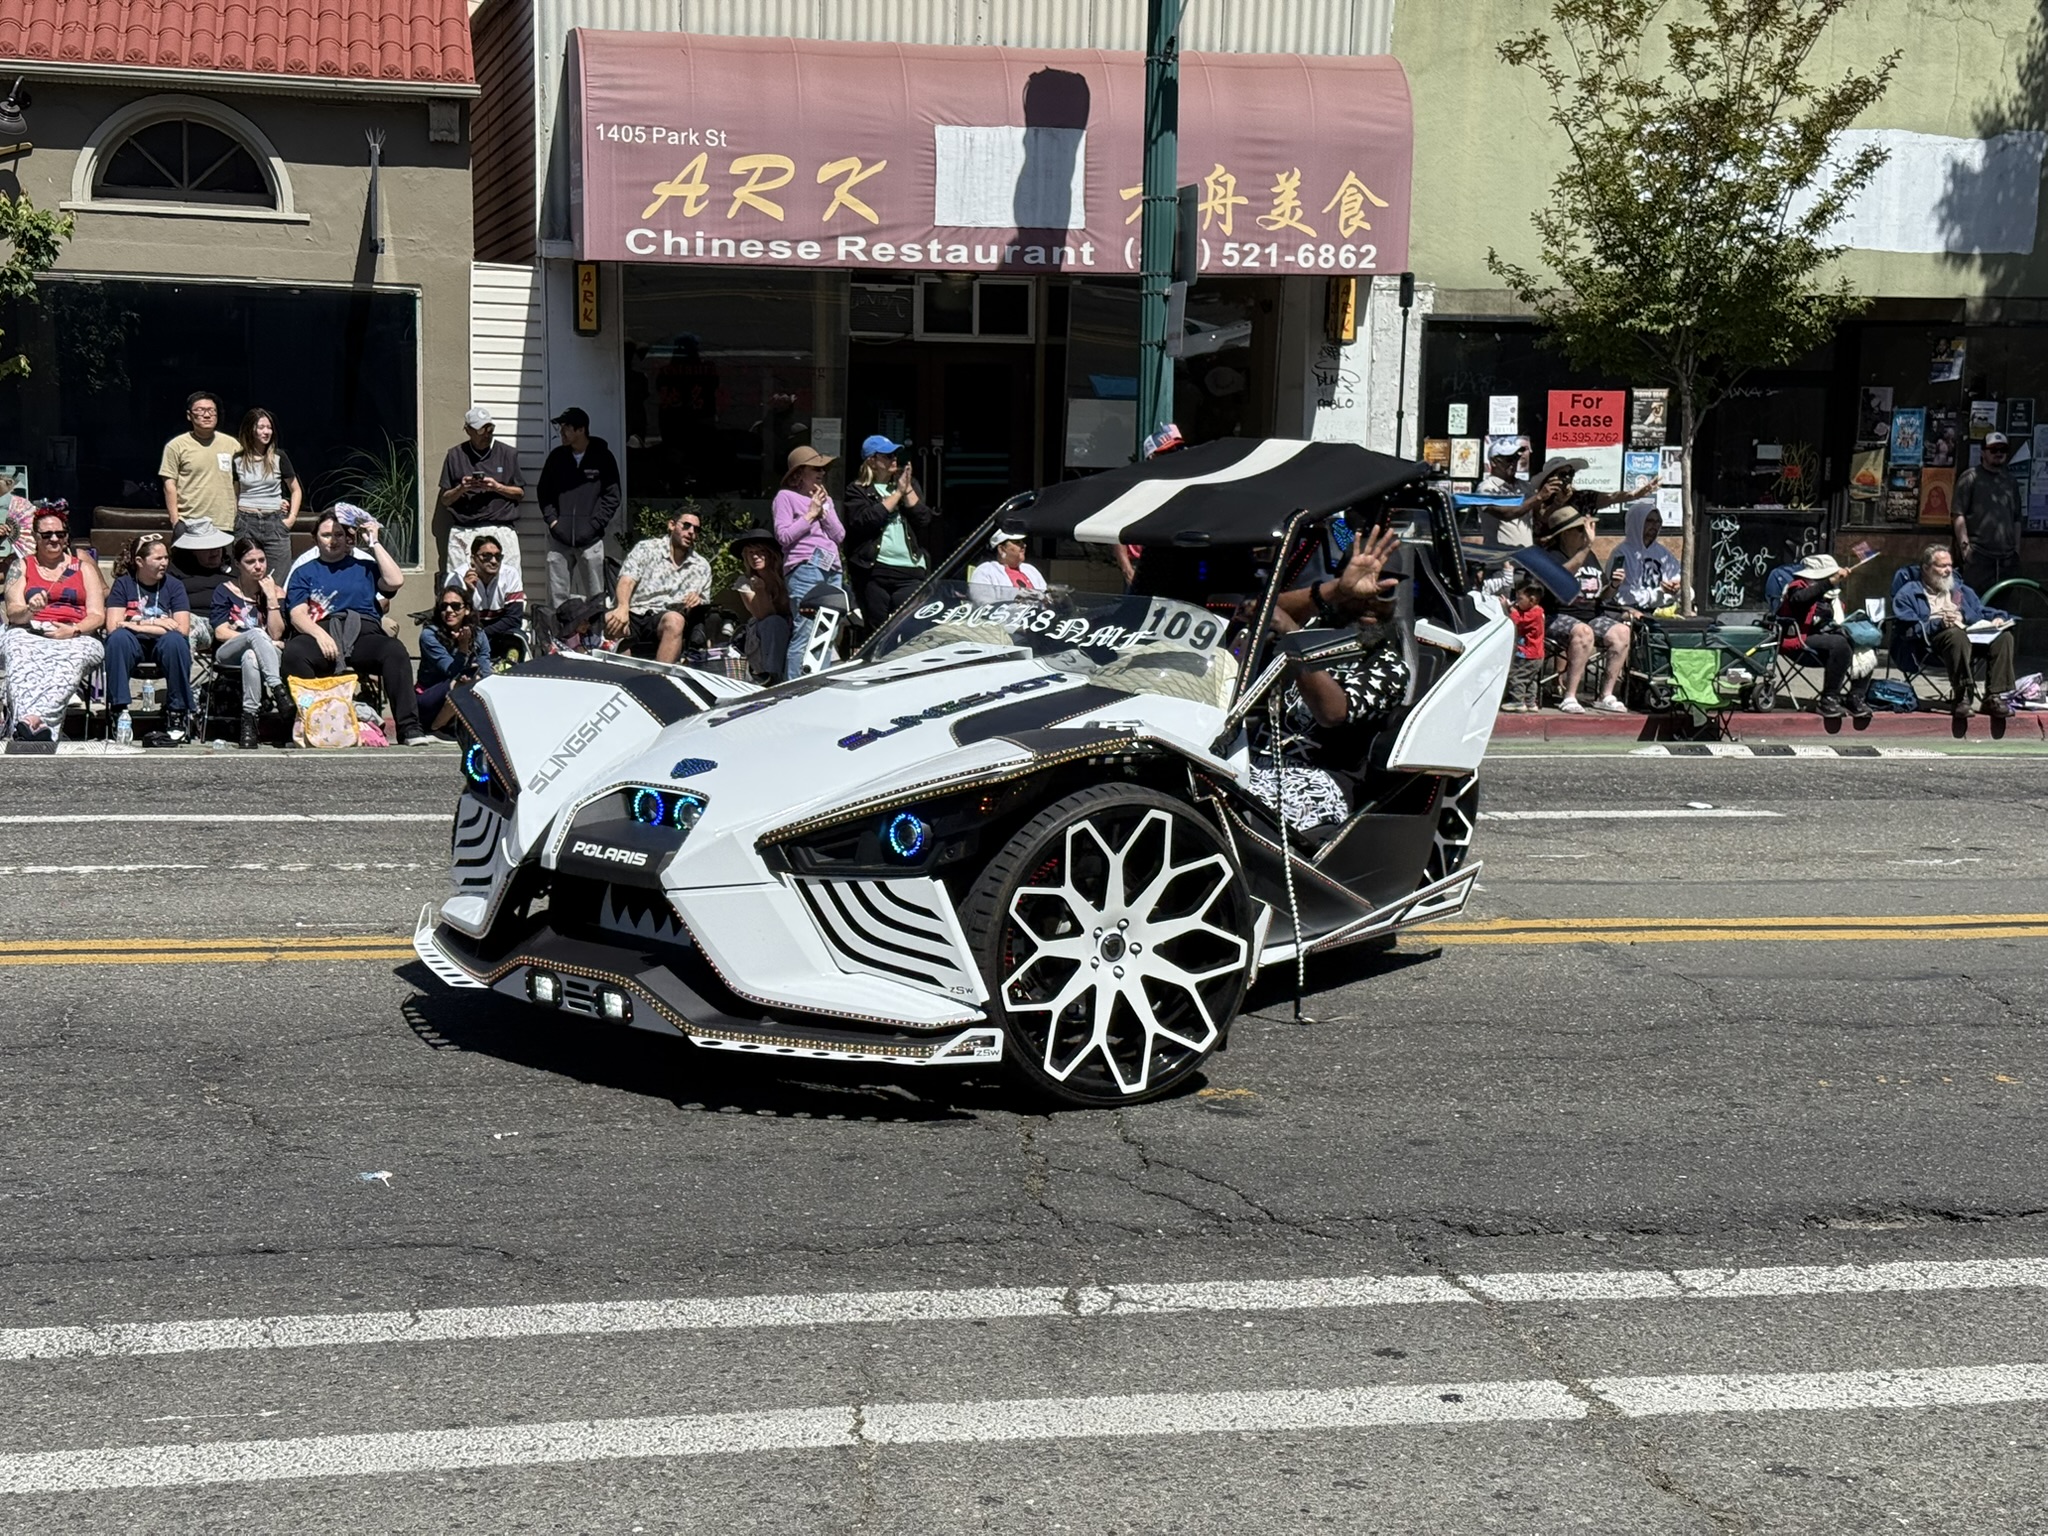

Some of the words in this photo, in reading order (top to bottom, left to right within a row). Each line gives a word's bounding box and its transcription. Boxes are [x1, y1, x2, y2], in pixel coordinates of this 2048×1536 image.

[595, 123, 646, 143] 1405
[652, 127, 700, 146] Park
[705, 129, 727, 147] St
[641, 152, 887, 225] ARK
[1119, 163, 1389, 238] 舟美食
[625, 228, 821, 260] Chinese
[837, 235, 1095, 266] Restaurant
[1221, 242, 1377, 269] 521-6862
[581, 271, 594, 323] ARK
[1558, 412, 1613, 427] Lease
[1571, 394, 1603, 409] For
[1552, 432, 1619, 443] 415.395.7262
[1151, 606, 1218, 650] 109
[838, 673, 1068, 751] SLINGSHOT
[527, 691, 629, 795] SLINGSHOT
[572, 841, 649, 866] POLARIS
